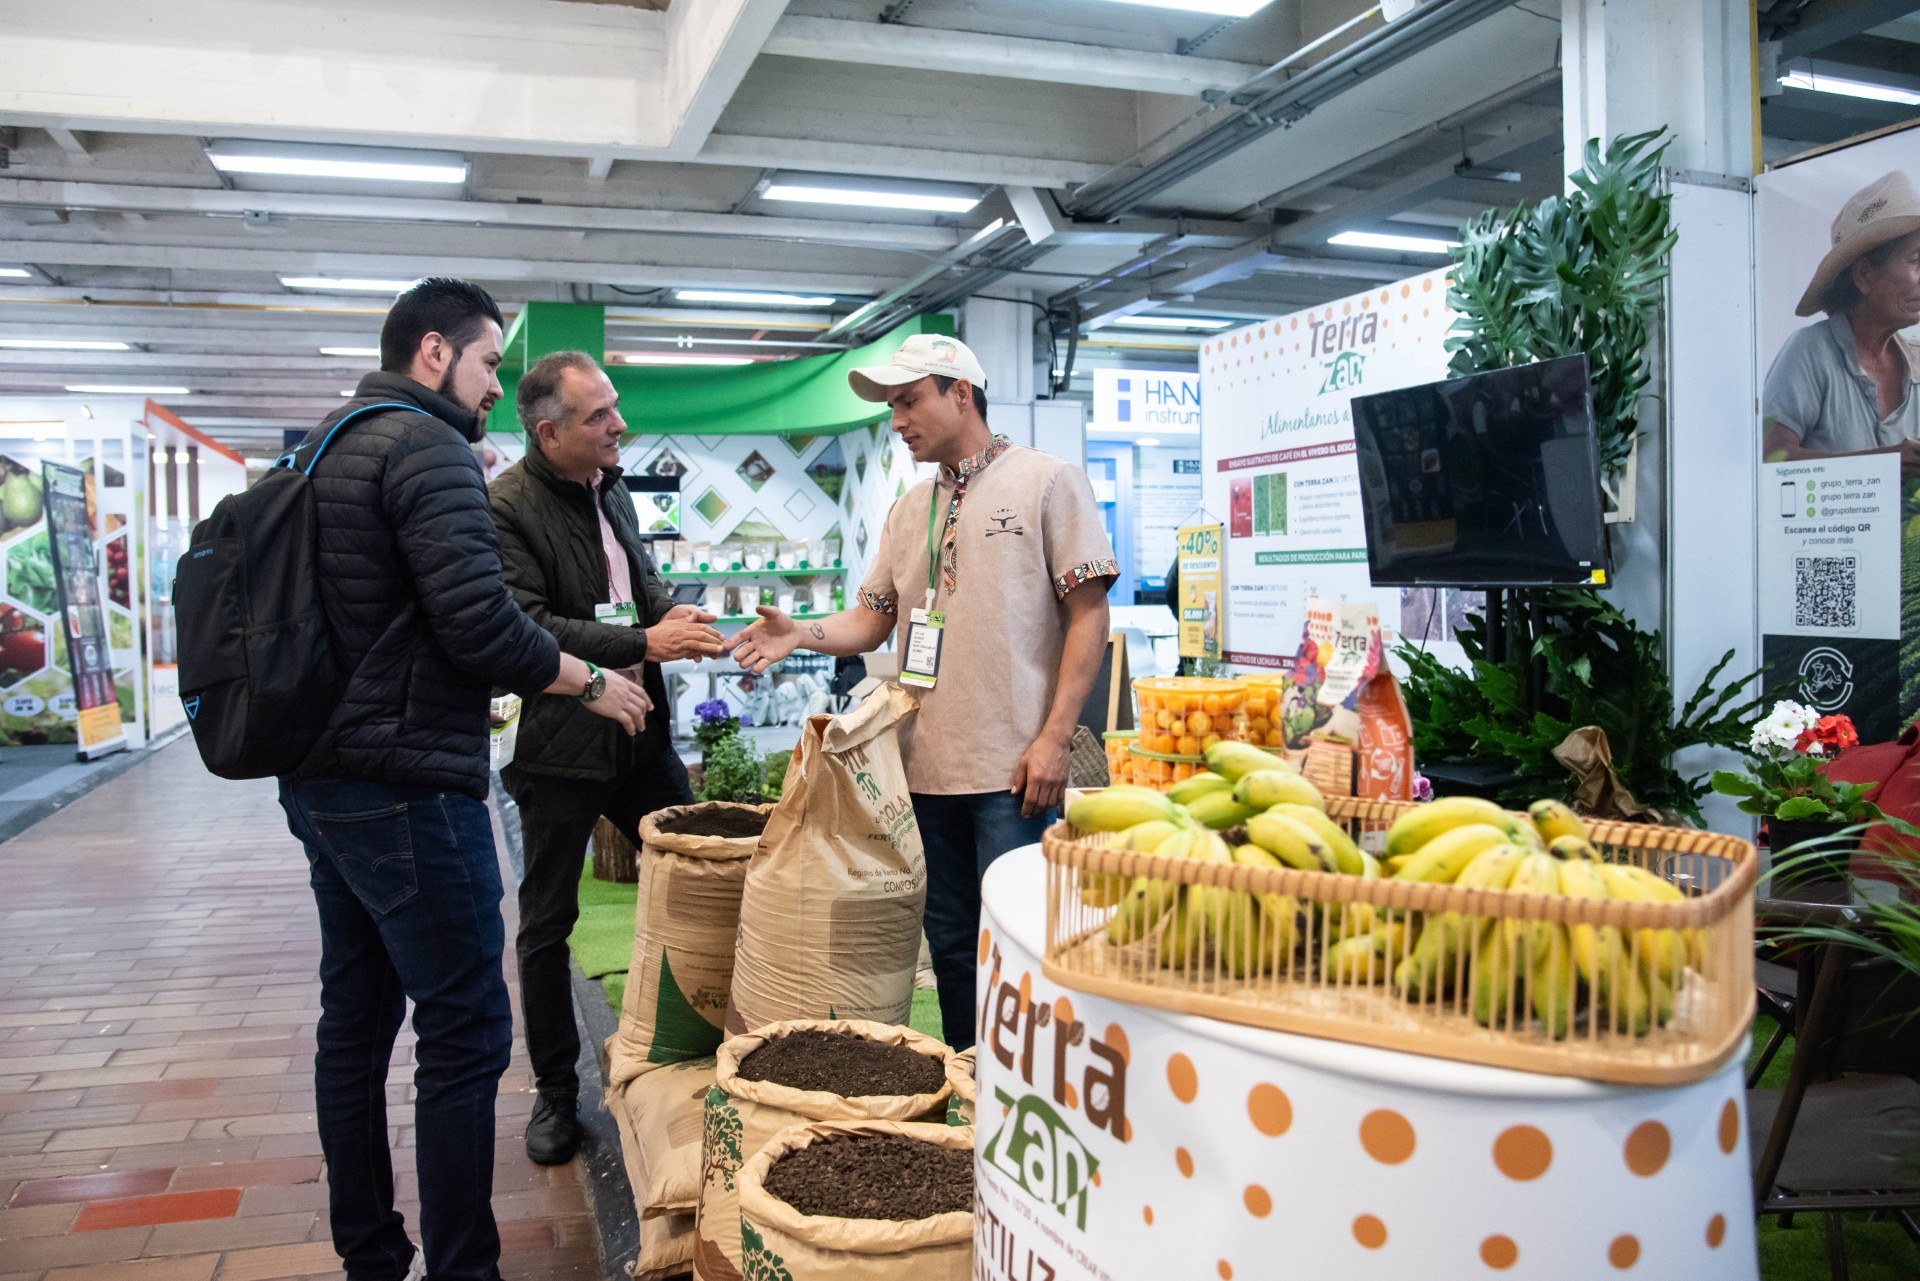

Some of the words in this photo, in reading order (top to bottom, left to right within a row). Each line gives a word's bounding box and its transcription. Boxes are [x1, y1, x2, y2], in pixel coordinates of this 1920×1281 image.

[1309, 312, 1378, 358] Terra
[1308, 446, 1329, 457] VIVERO
[1776, 467, 1811, 477] Síguenos
[1820, 477, 1881, 489] grupo_terra_zan
[1820, 494, 1842, 502] grupo
[1843, 492, 1860, 500] terra
[1862, 491, 1876, 499] zan
[1821, 506, 1880, 517] @grupoterrazan
[1784, 526, 1816, 534] Escanea
[1818, 525, 1826, 533] el
[1827, 524, 1855, 534] código
[1857, 523, 1871, 532] QR
[1181, 530, 1218, 555] -40%
[1802, 538, 1807, 546] y
[1808, 537, 1835, 545] conoce
[1837, 536, 1854, 544] más
[1334, 552, 1351, 560] PARA
[1335, 631, 1367, 652] Terra
[980, 942, 1129, 1145] Terra
